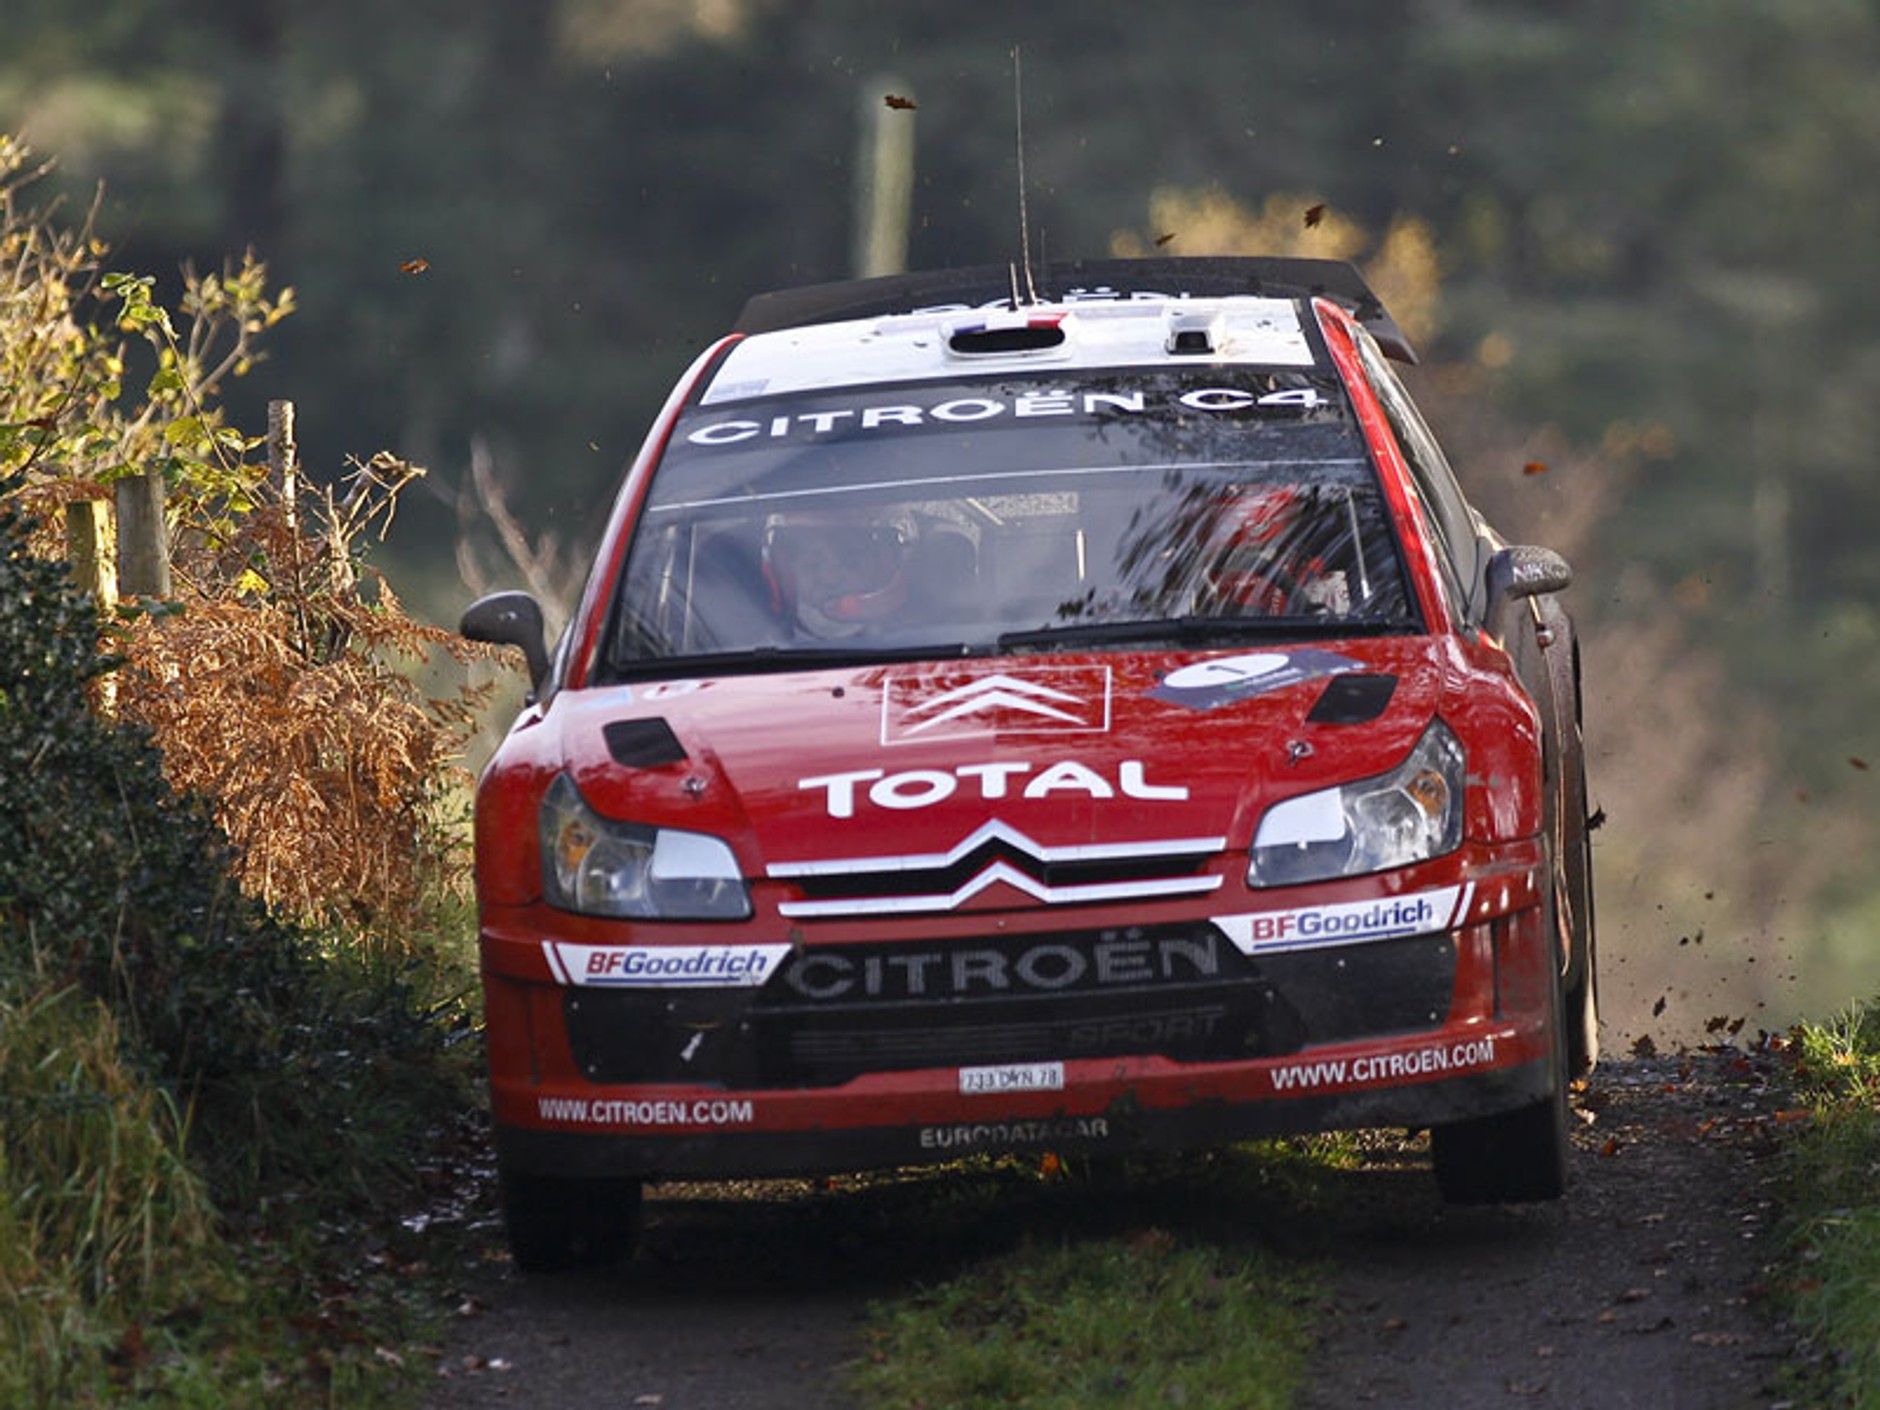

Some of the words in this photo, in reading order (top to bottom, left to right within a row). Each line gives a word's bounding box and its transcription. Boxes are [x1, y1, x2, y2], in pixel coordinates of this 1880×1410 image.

[687, 389, 1144, 444] CITROËN
[1179, 389, 1329, 411] C4
[798, 760, 1189, 819] TOTAL
[1251, 898, 1433, 942] BFGoodrich
[585, 949, 768, 975] BFGoodrich
[786, 926, 1220, 999] CITROËN
[1270, 1039, 1495, 1090] WWW.CITROEN.COM
[538, 1098, 754, 1124] WWW.CITROEN.COM
